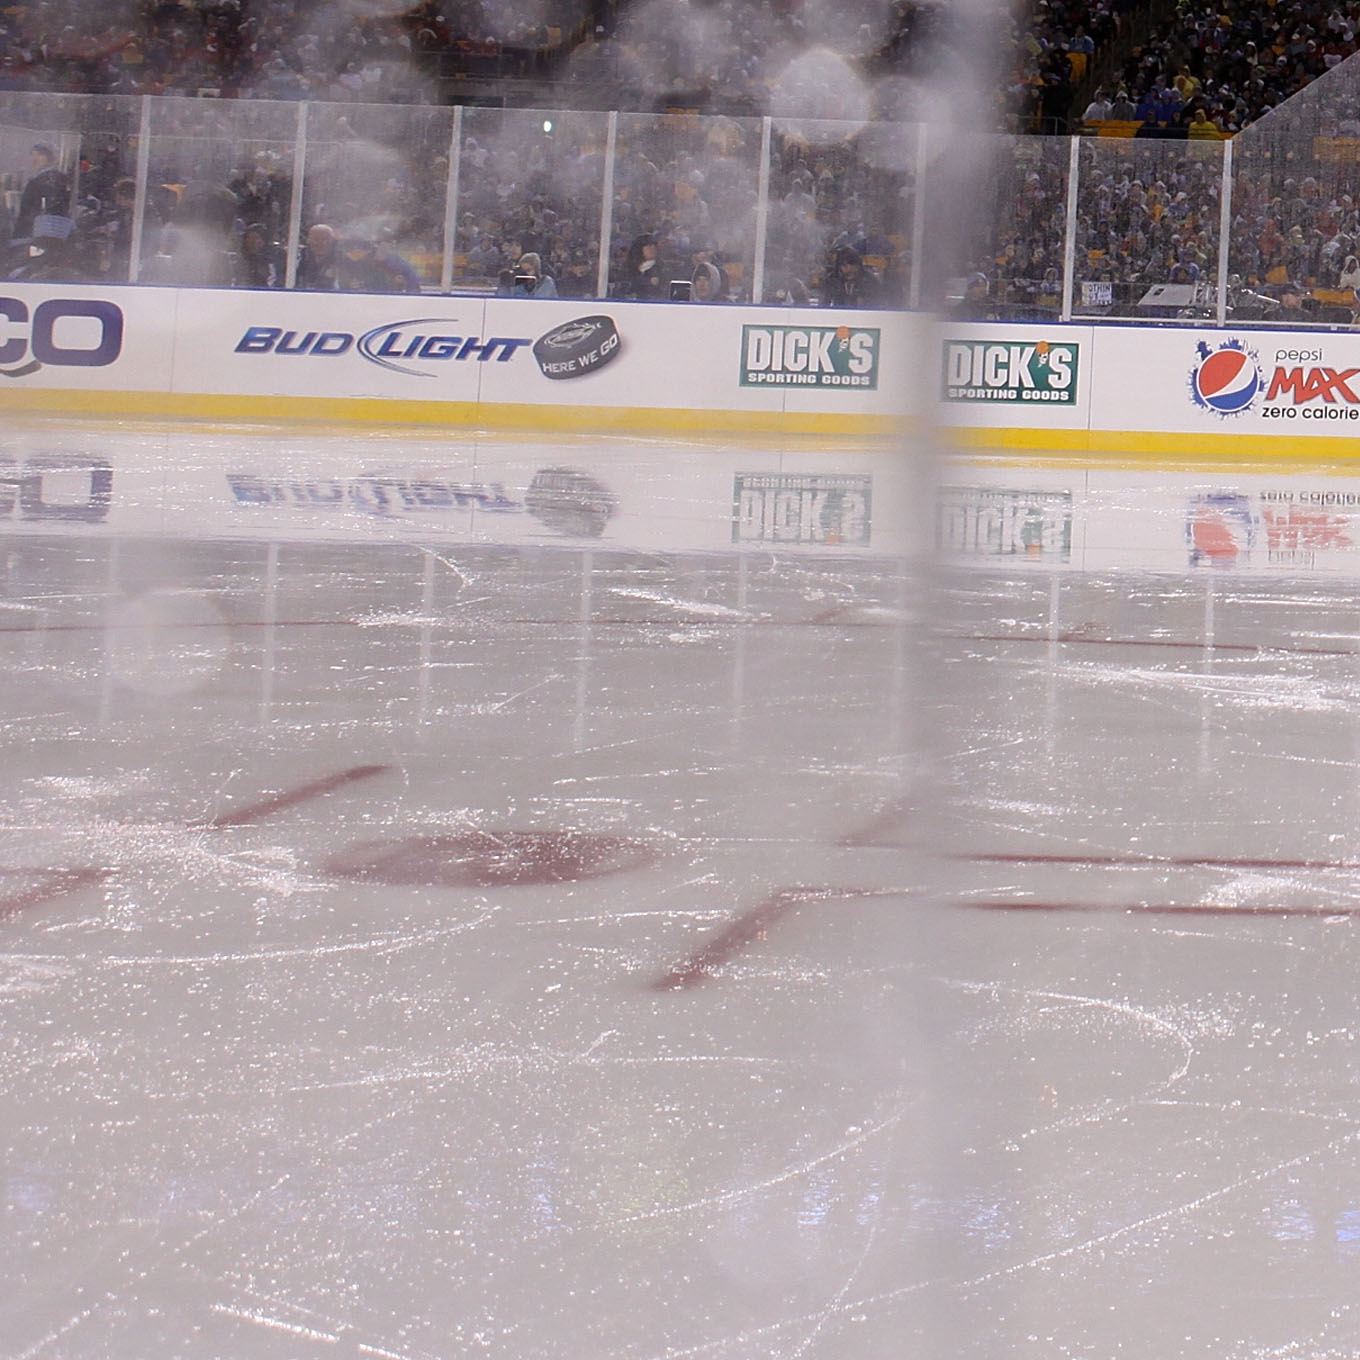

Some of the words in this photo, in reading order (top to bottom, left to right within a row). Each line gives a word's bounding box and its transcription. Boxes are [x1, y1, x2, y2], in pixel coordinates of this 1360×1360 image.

[235, 326, 354, 357] BUD
[375, 331, 533, 362] LIGHT
[542, 359, 577, 373] HERE
[578, 348, 600, 368] WE
[599, 333, 619, 357] GO
[747, 330, 874, 373] DICK'S
[1276, 347, 1323, 363] pepsi
[946, 342, 1073, 387] DICK'S
[747, 372, 817, 384] SPORTING
[820, 373, 871, 385] GOODS
[947, 387, 1020, 400] SPORTING
[1022, 388, 1070, 401] GOODS
[1262, 406, 1296, 420] zero
